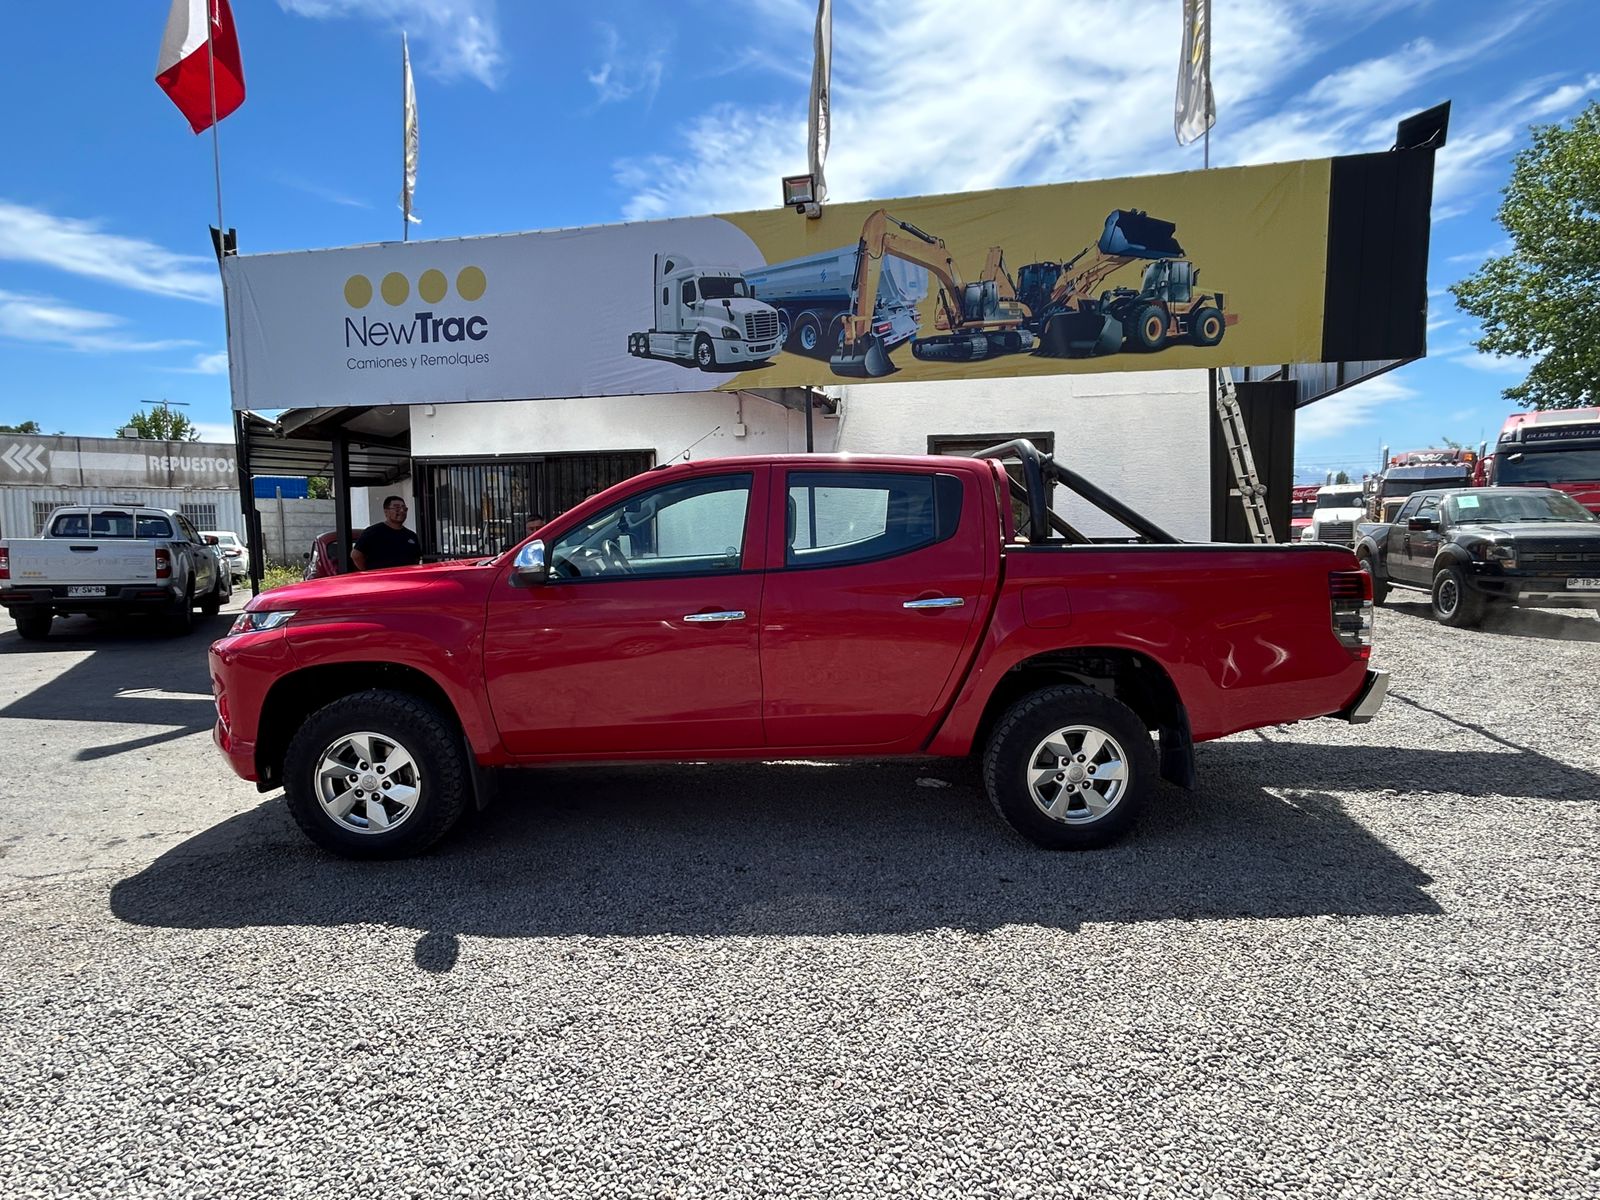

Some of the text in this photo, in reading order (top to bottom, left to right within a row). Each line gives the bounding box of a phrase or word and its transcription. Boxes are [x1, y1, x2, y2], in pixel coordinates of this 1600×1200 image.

[345, 311, 489, 348] NewTrac
[346, 352, 490, 370] Camiones y Remolques
[148, 455, 235, 473] REPUESTOS
